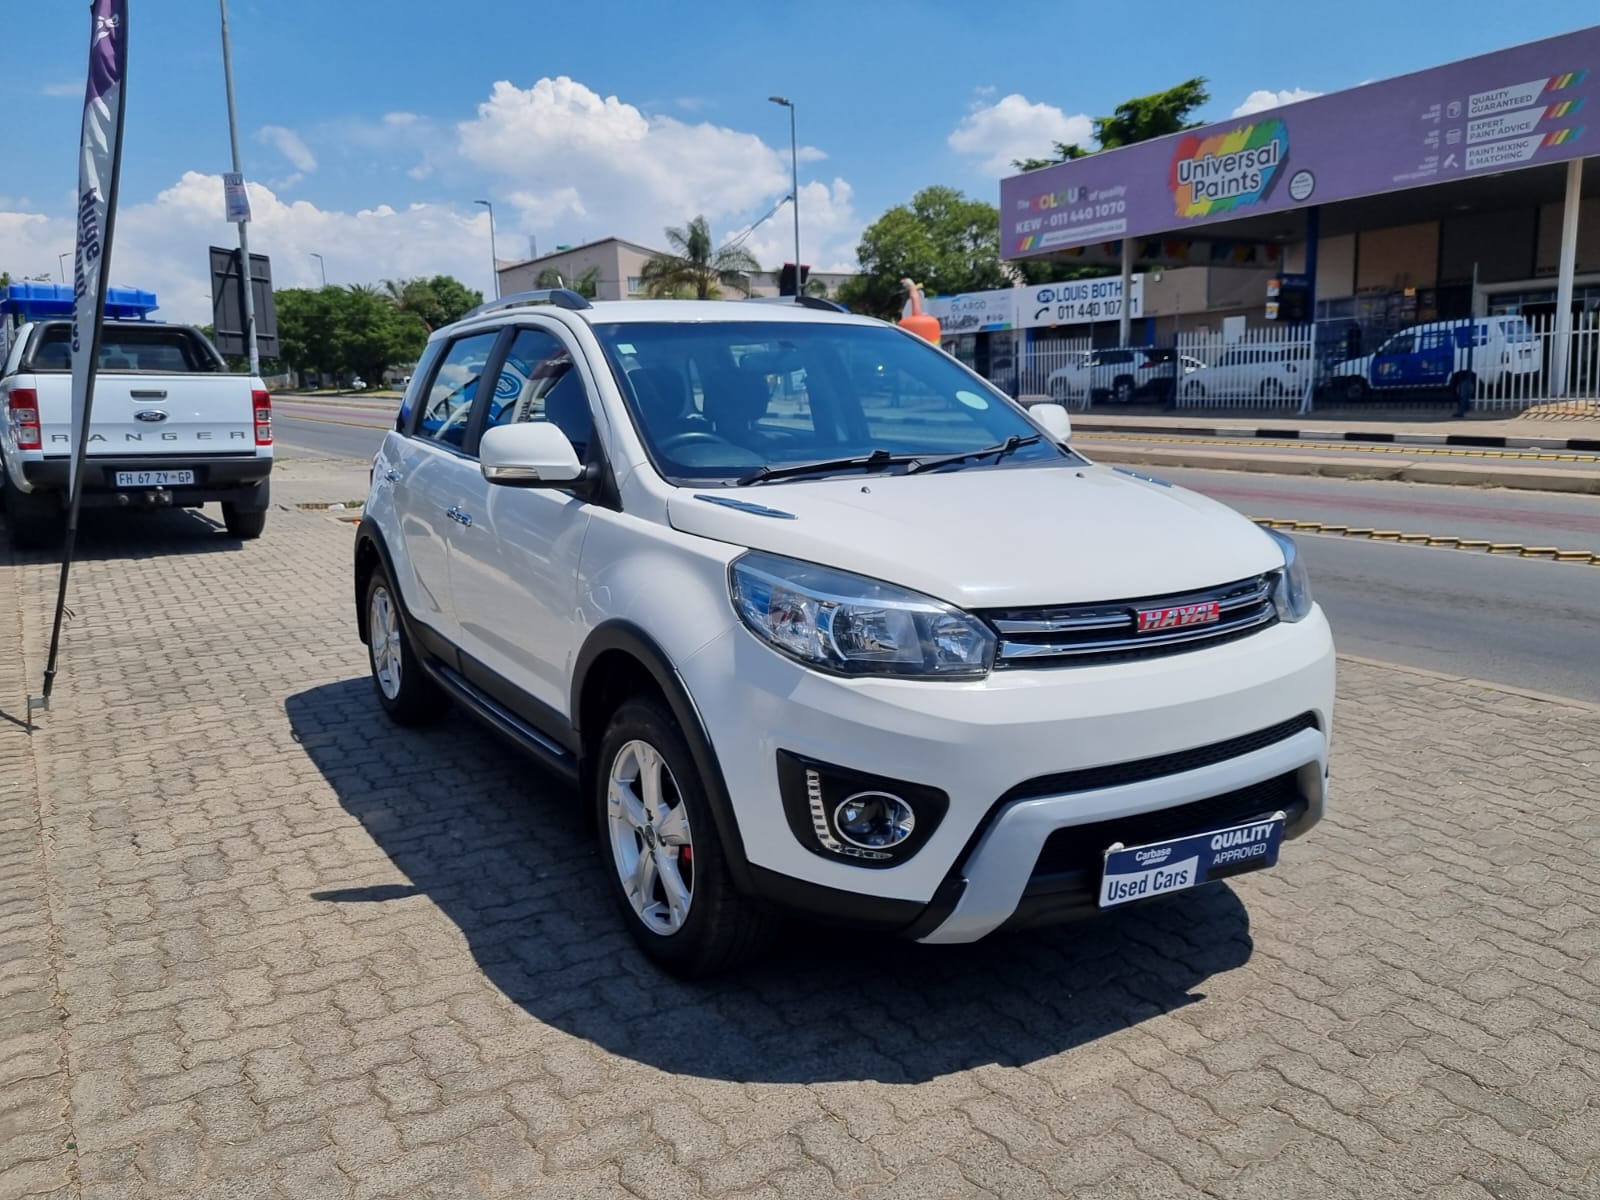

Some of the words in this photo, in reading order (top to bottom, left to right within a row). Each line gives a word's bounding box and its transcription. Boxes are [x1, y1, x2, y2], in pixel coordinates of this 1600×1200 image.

[1471, 94, 1533, 114] GUARANTEED
[1472, 91, 1509, 106] QUALITY
[1470, 118, 1504, 131] EXPERT
[1470, 129, 1496, 140] PAINT
[1498, 122, 1531, 136] ADVICE
[1469, 146, 1495, 157] PAINT
[1496, 140, 1529, 153] MIXING
[1476, 151, 1523, 165] MATCHING
[1179, 140, 1278, 182] Universal
[1193, 172, 1260, 200] Paints
[1030, 186, 1088, 212] COLOUR
[1015, 217, 1042, 234] KEW
[1050, 212, 1068, 227] 011
[1070, 207, 1093, 222] 440
[1095, 200, 1126, 217] 1070
[1056, 285, 1088, 302] LOUIS
[1092, 281, 1124, 299] BOTH
[1058, 304, 1075, 320] 011
[1078, 301, 1101, 317] 440
[51, 431, 246, 443] RANGER
[120, 472, 133, 485] FH
[138, 472, 150, 484] 67
[155, 471, 168, 484] ZY
[178, 471, 191, 483] GP
[1143, 602, 1219, 630] HAVAL
[1210, 823, 1274, 850] QUALITY
[1135, 847, 1172, 862] Carbase
[1212, 842, 1267, 865] APPROVED
[1107, 874, 1149, 901] Used
[1152, 869, 1189, 891] Cars
